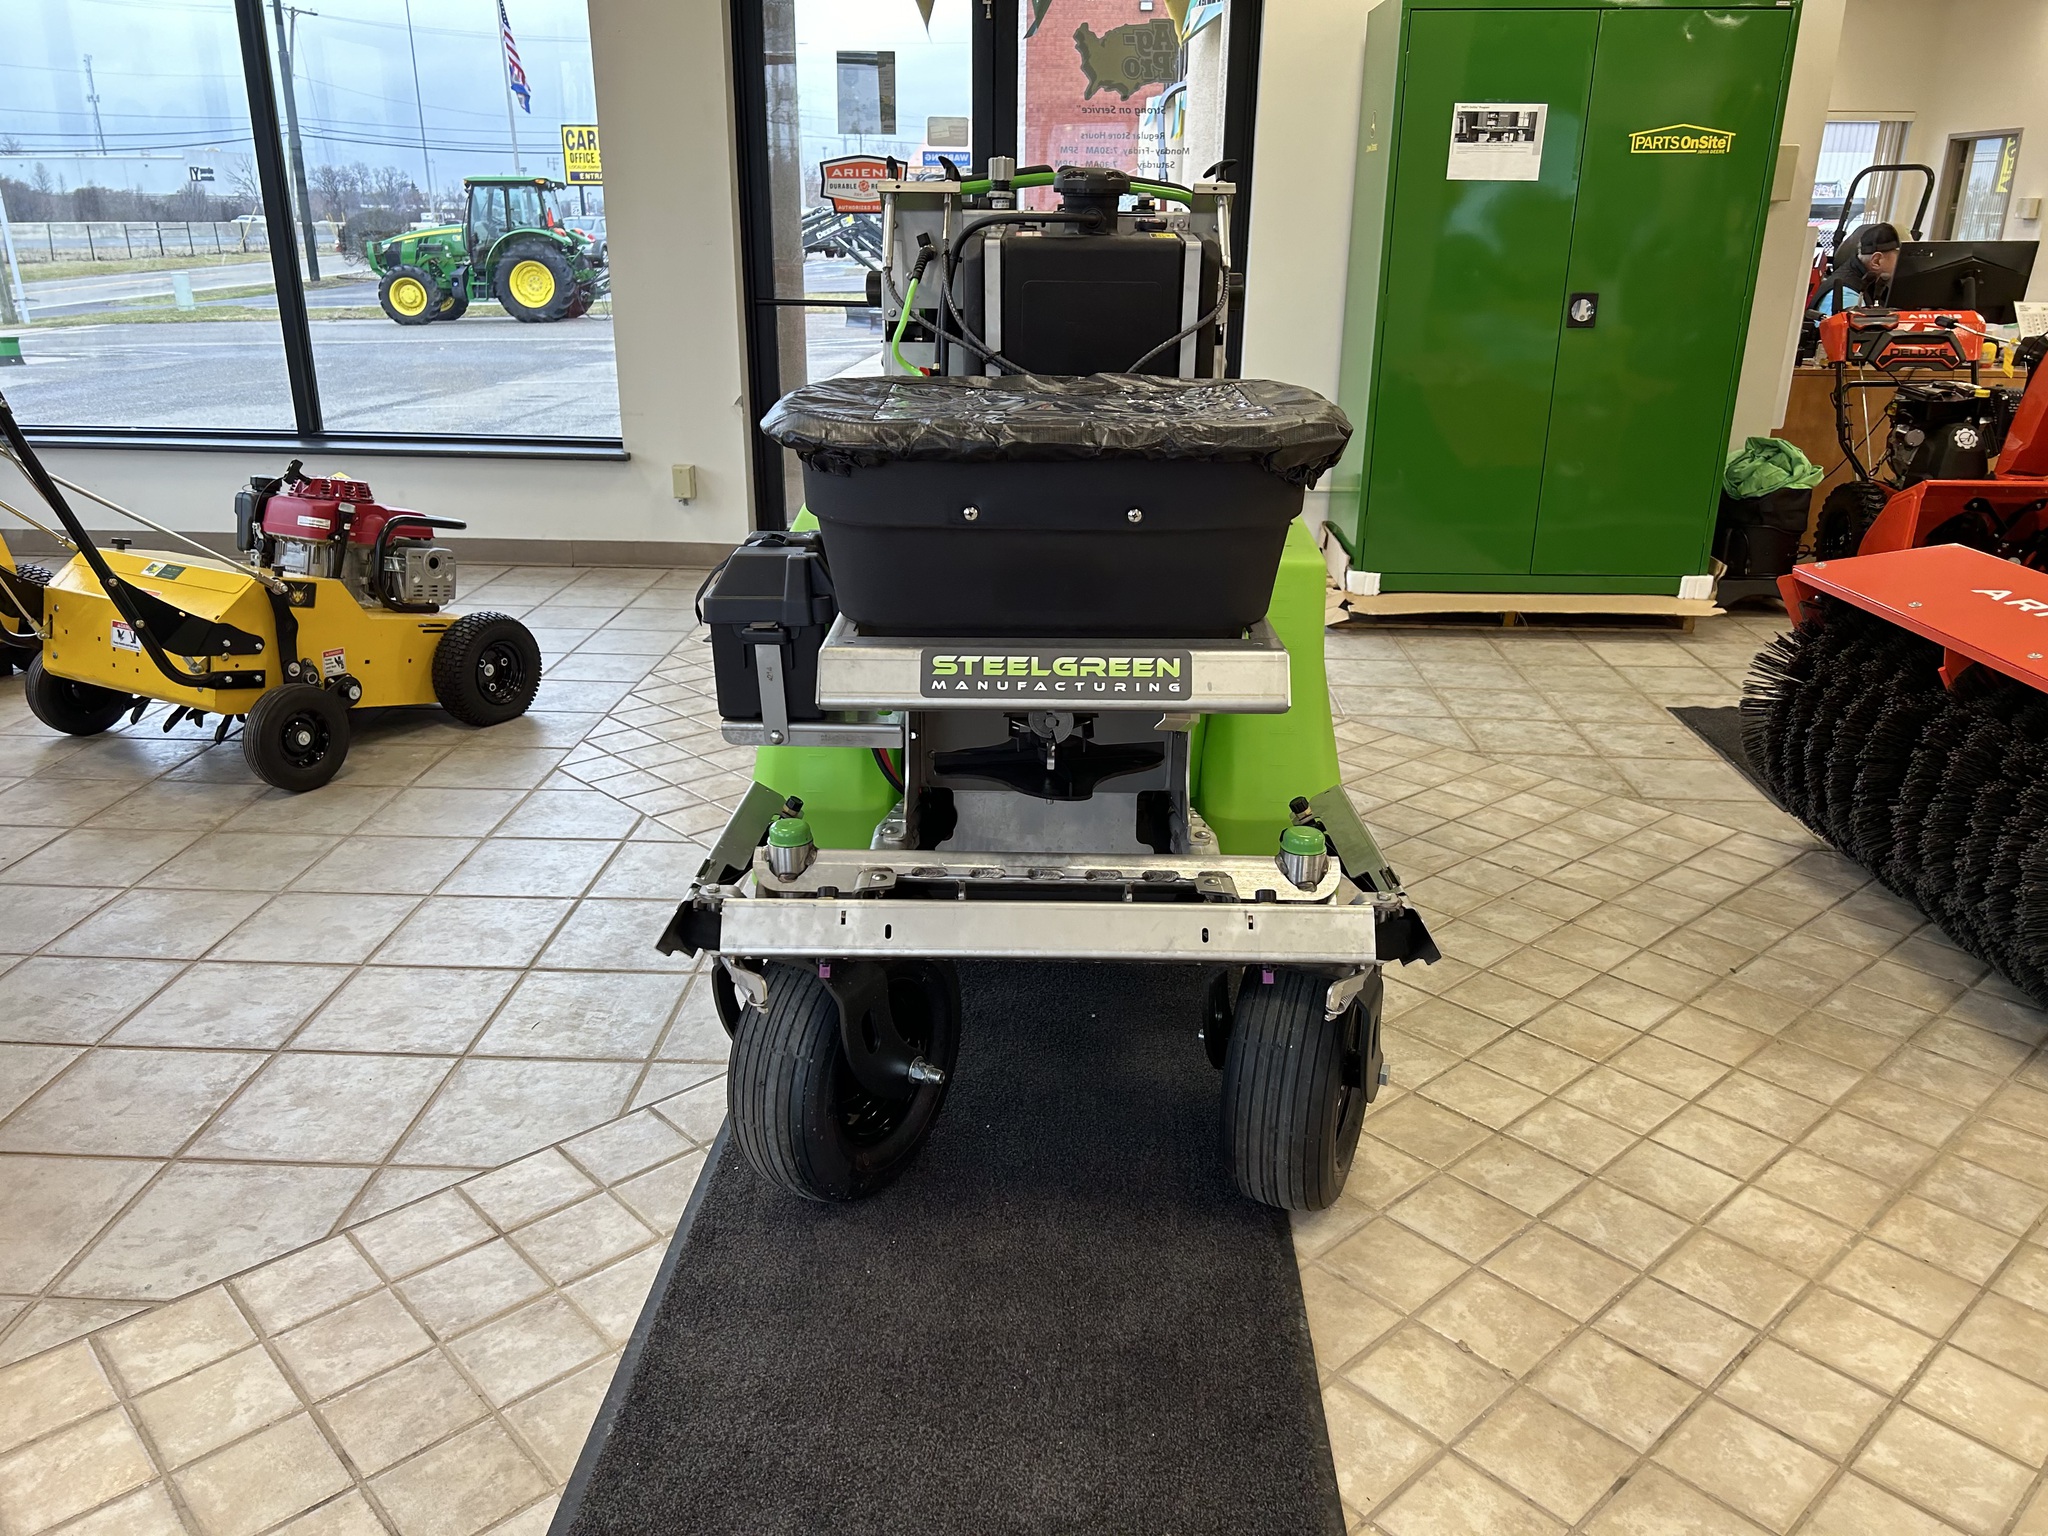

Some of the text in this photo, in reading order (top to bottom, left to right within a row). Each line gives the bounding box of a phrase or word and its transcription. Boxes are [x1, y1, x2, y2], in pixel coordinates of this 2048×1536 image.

[570, 152, 595, 163] OFFICE
[1890, 348, 1949, 356] DELUXE
[931, 655, 1181, 678] STEELGREEN
[931, 679, 1181, 693] MANUFACTURING
